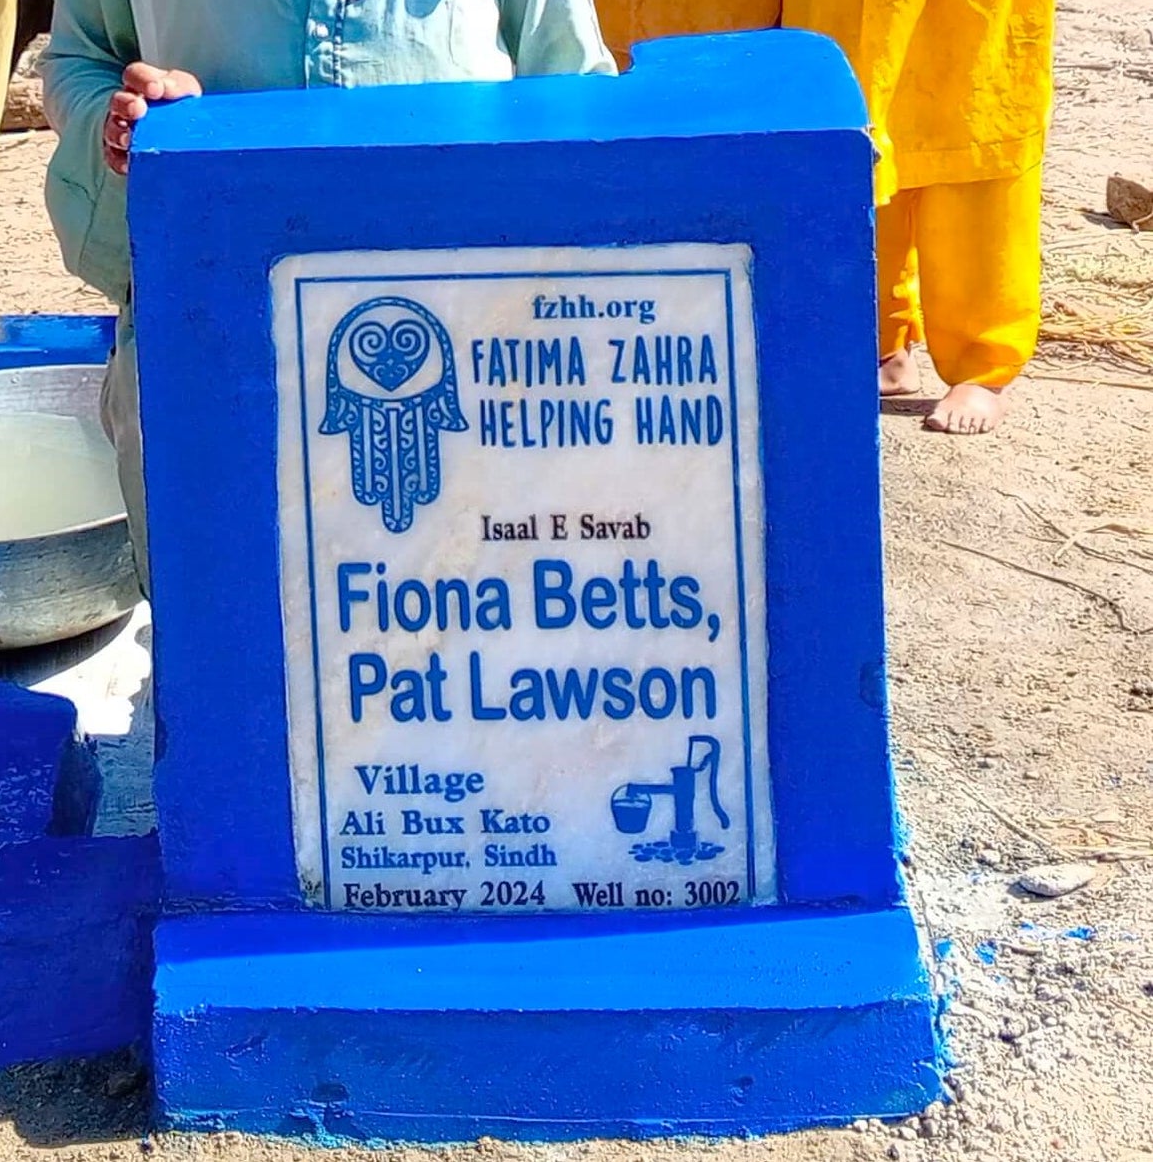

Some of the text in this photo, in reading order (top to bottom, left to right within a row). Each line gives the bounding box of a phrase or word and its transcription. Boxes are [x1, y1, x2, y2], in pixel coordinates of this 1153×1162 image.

[532, 294, 656, 324] fzhh.org
[471, 334, 717, 387] FATIMA ZAHRA
[480, 394, 724, 448] HELPING HAND
[481, 513, 651, 541] Isaal E Savab
[337, 559, 721, 642] Fiona Betts,
[348, 650, 717, 723] Pat Lawson
[354, 765, 485, 799] Village
[339, 810, 550, 836] Ali Bux Kato
[484, 845, 557, 868] Sindh
[343, 880, 741, 910] February 2024 Well no: 3002
